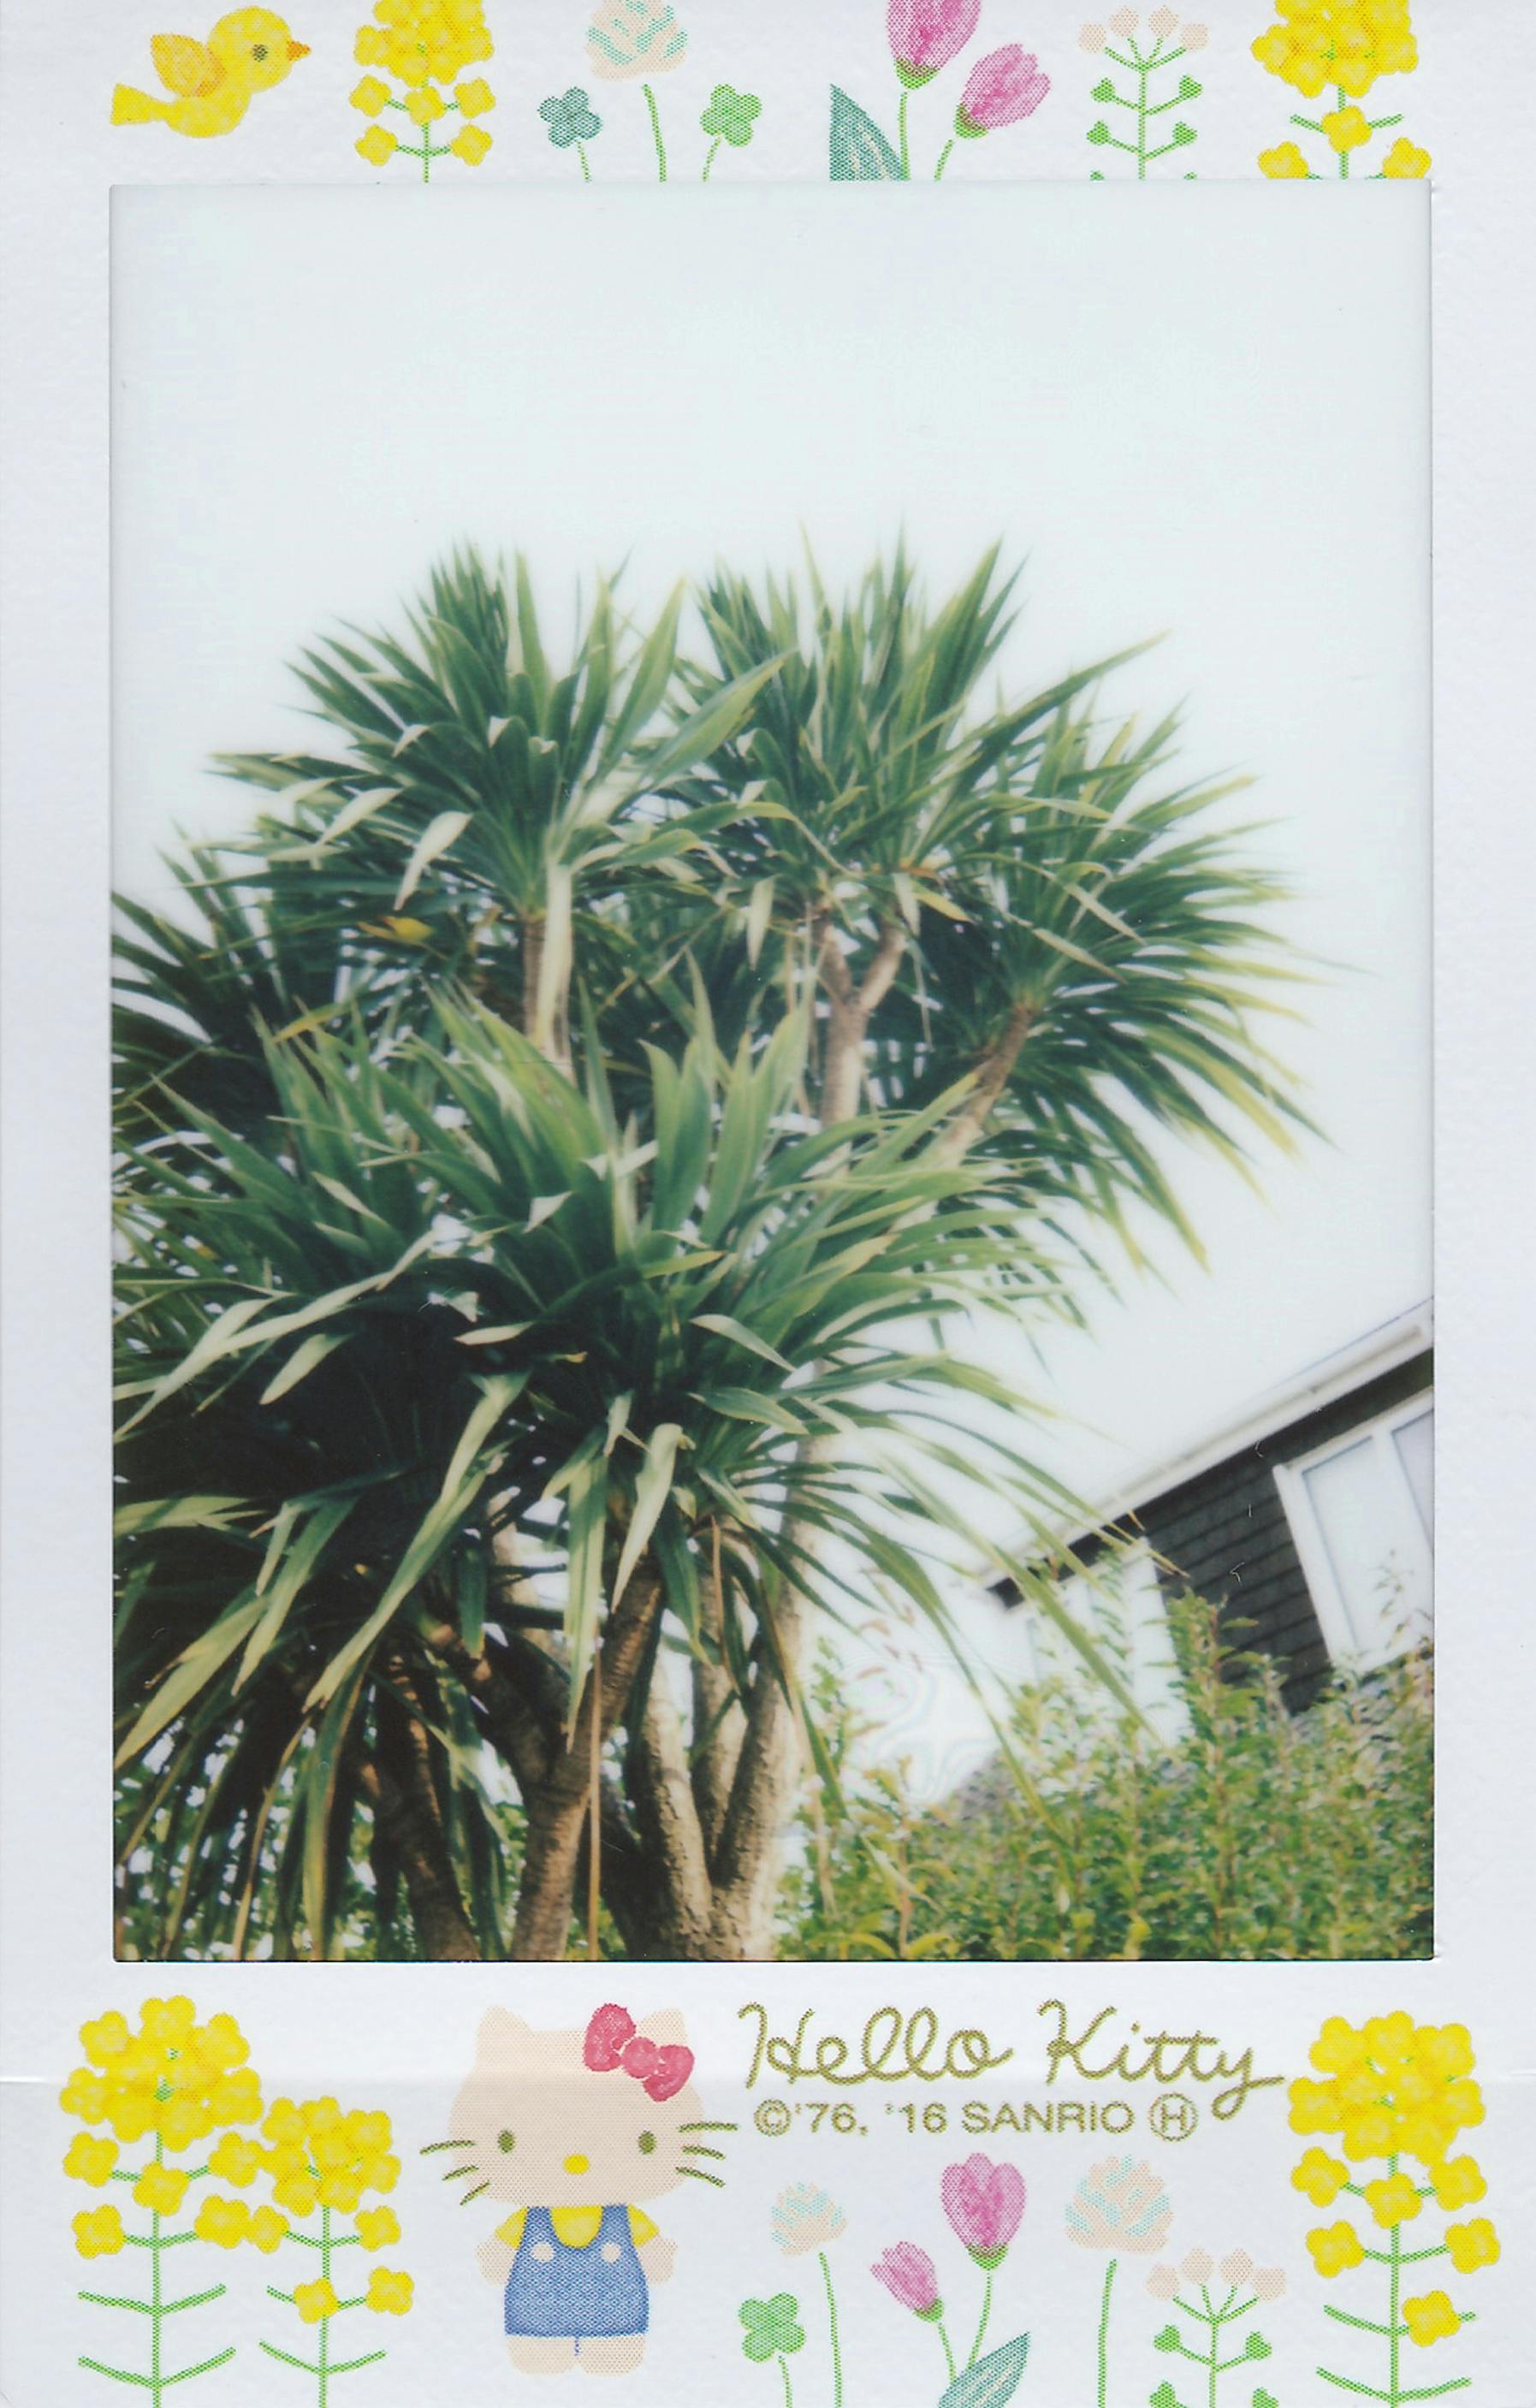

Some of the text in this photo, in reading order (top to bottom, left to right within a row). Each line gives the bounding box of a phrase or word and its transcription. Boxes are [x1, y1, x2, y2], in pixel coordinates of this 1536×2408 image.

[738, 1998, 1285, 2120] Hello Kitty
[961, 2101, 1135, 2133] SANRIO
